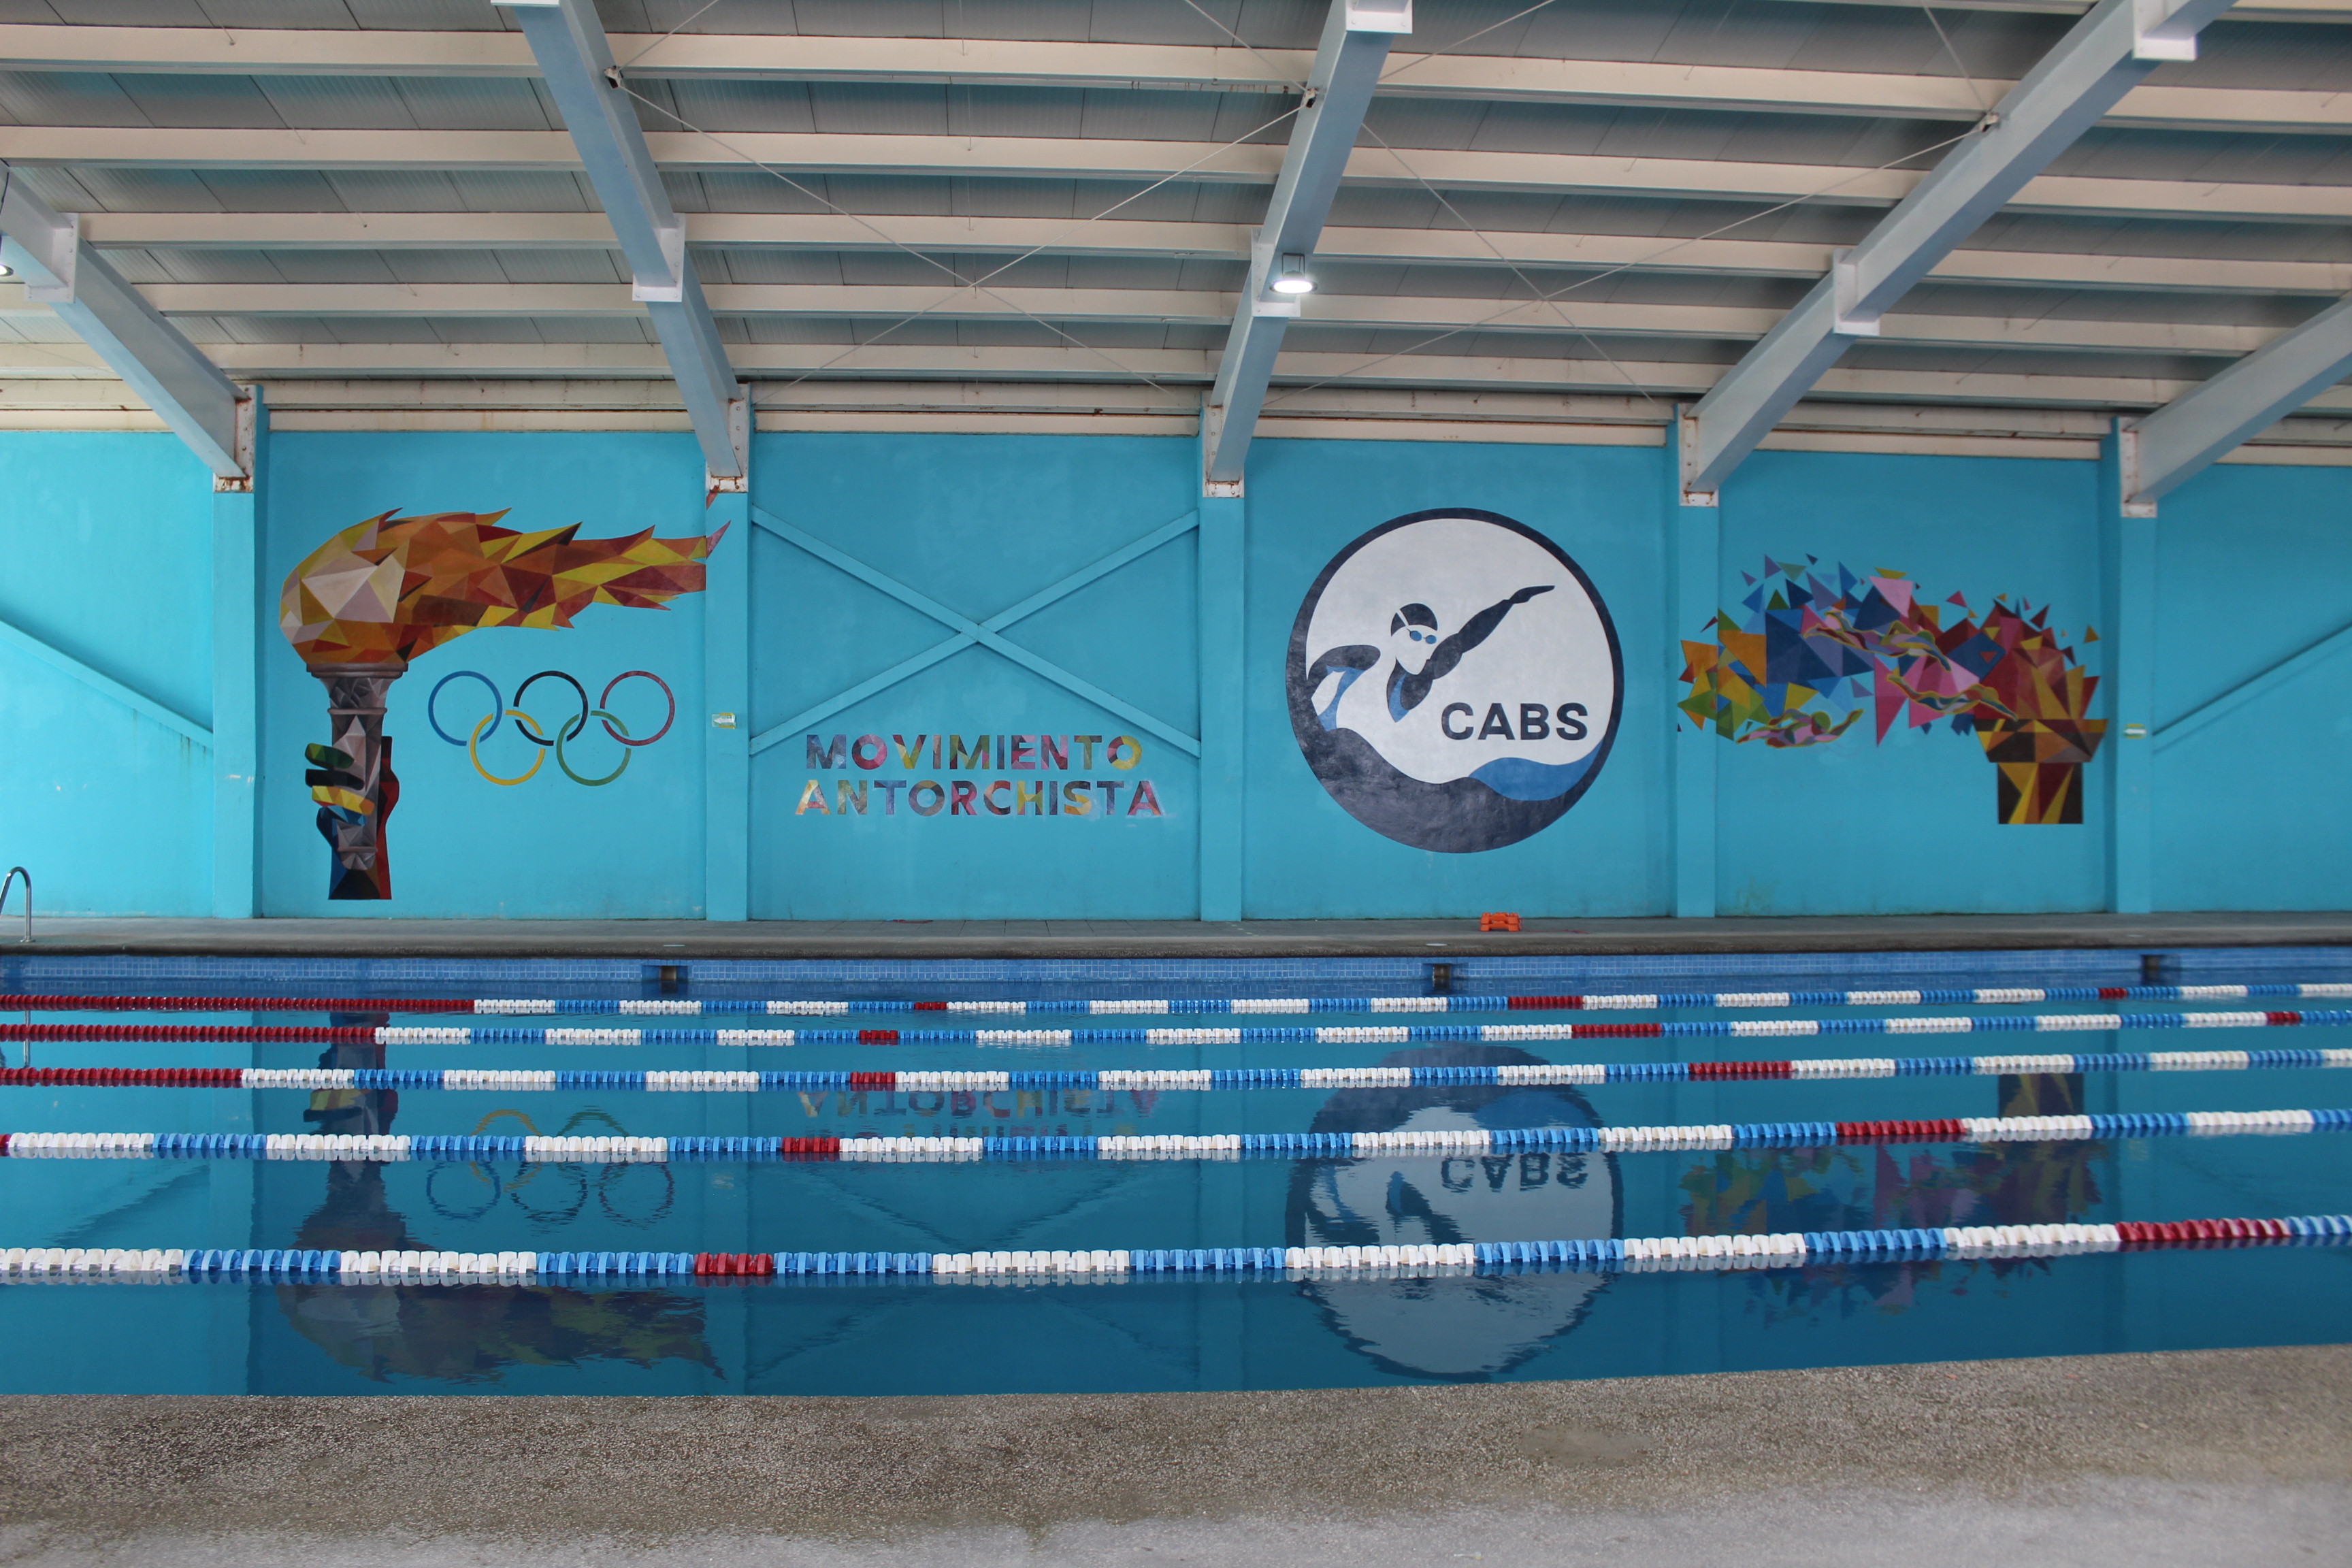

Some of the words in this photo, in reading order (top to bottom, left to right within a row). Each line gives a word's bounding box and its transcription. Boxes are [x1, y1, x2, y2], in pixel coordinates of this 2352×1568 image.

[1441, 702, 1588, 741] CABS
[805, 734, 1143, 770] MOVIMIENTO
[795, 779, 1162, 817] ANTORCHISTA
